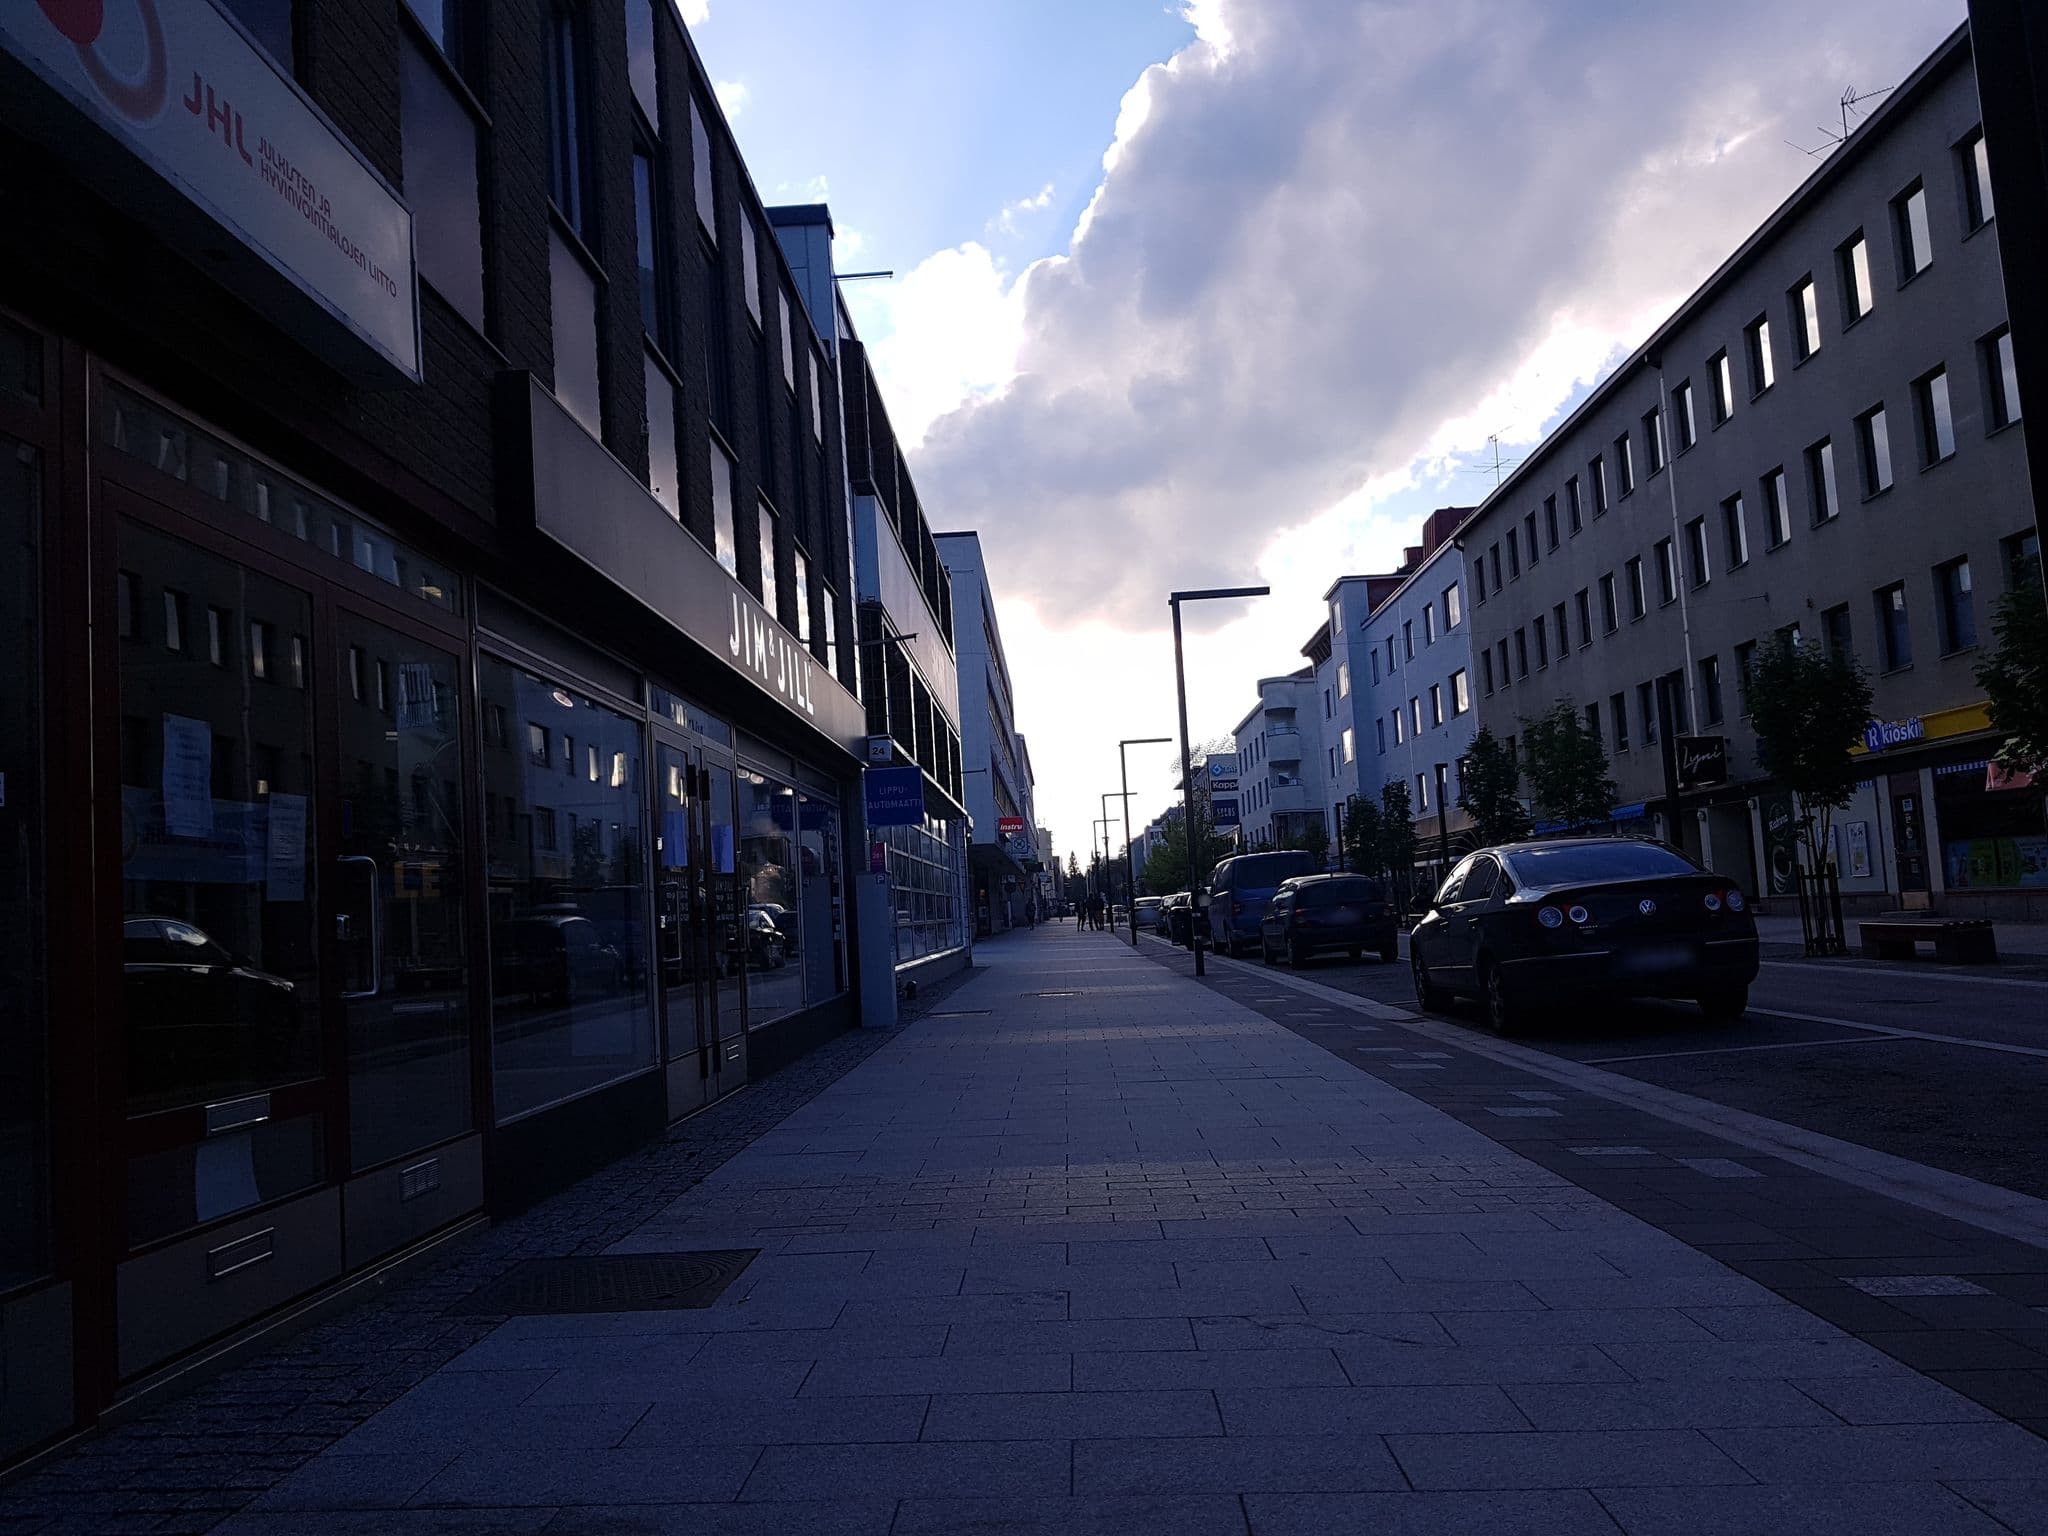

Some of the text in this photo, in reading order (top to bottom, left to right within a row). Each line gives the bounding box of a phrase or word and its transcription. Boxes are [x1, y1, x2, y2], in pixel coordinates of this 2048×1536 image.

[184, 72, 252, 168] JHL
[258, 137, 331, 218] JULKISTEN JA
[260, 159, 397, 298] HYVINVOINTIALOJEN LIITTO
[729, 592, 814, 716] JIM & JILL
[872, 746, 885, 756] 24
[1881, 716, 1919, 744] kioski
[867, 798, 921, 810] AUTOMAATTI
